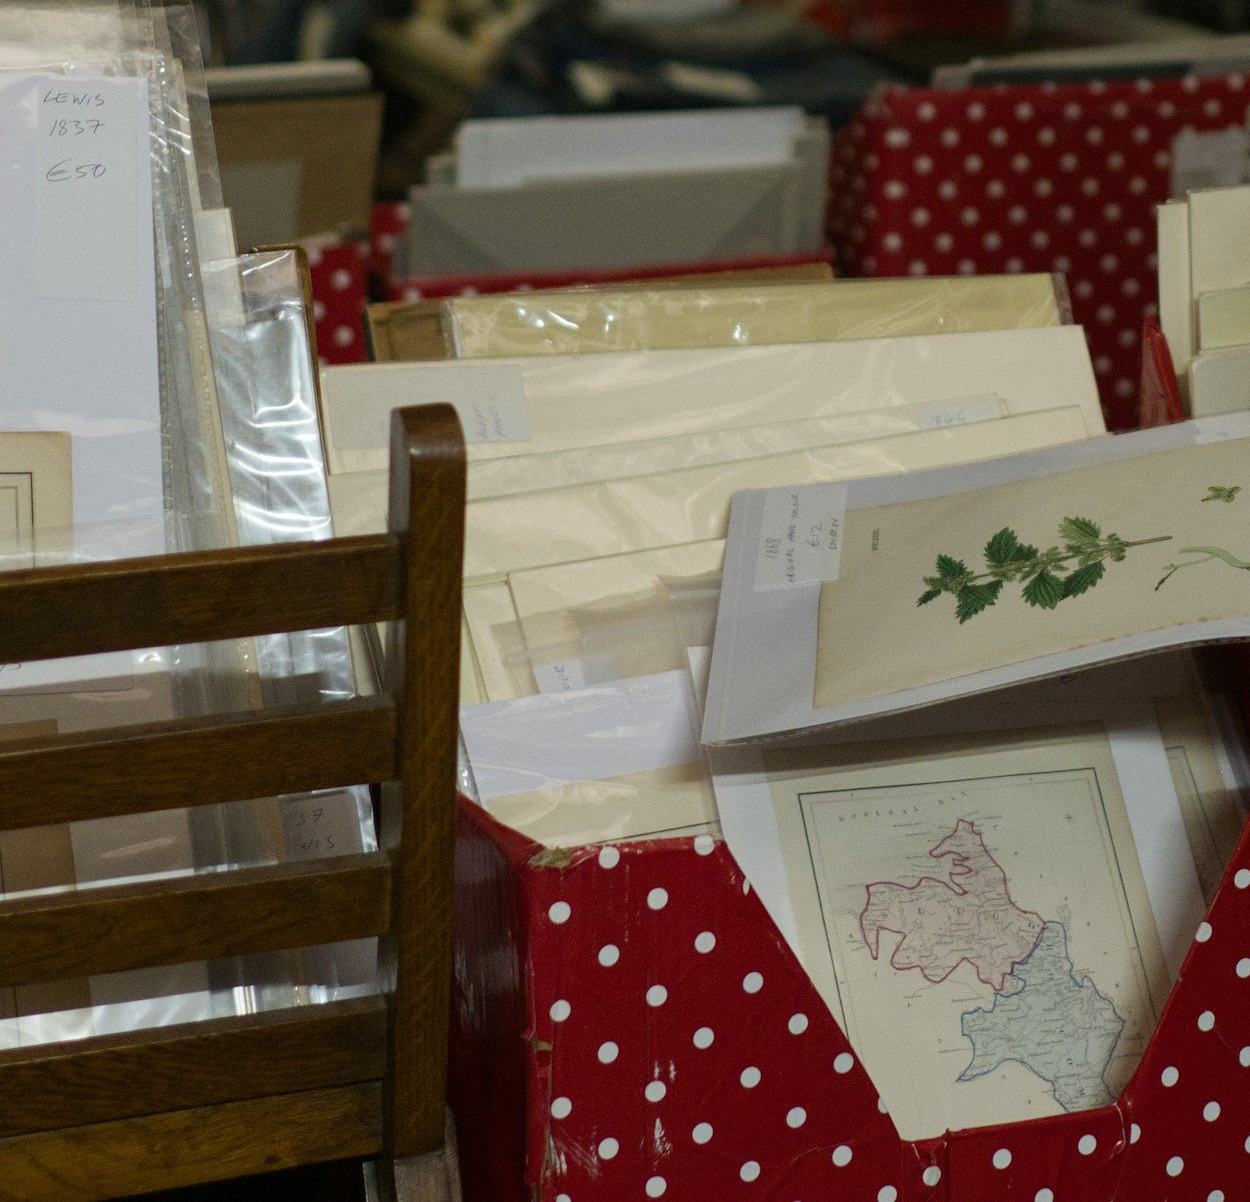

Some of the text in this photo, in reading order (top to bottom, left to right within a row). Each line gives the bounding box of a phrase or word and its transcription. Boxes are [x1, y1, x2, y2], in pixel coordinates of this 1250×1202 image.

[42, 89, 105, 108] LEWIS
[49, 118, 106, 137] 1837
[45, 158, 107, 183] €50
[762, 537, 782, 559] 1868
